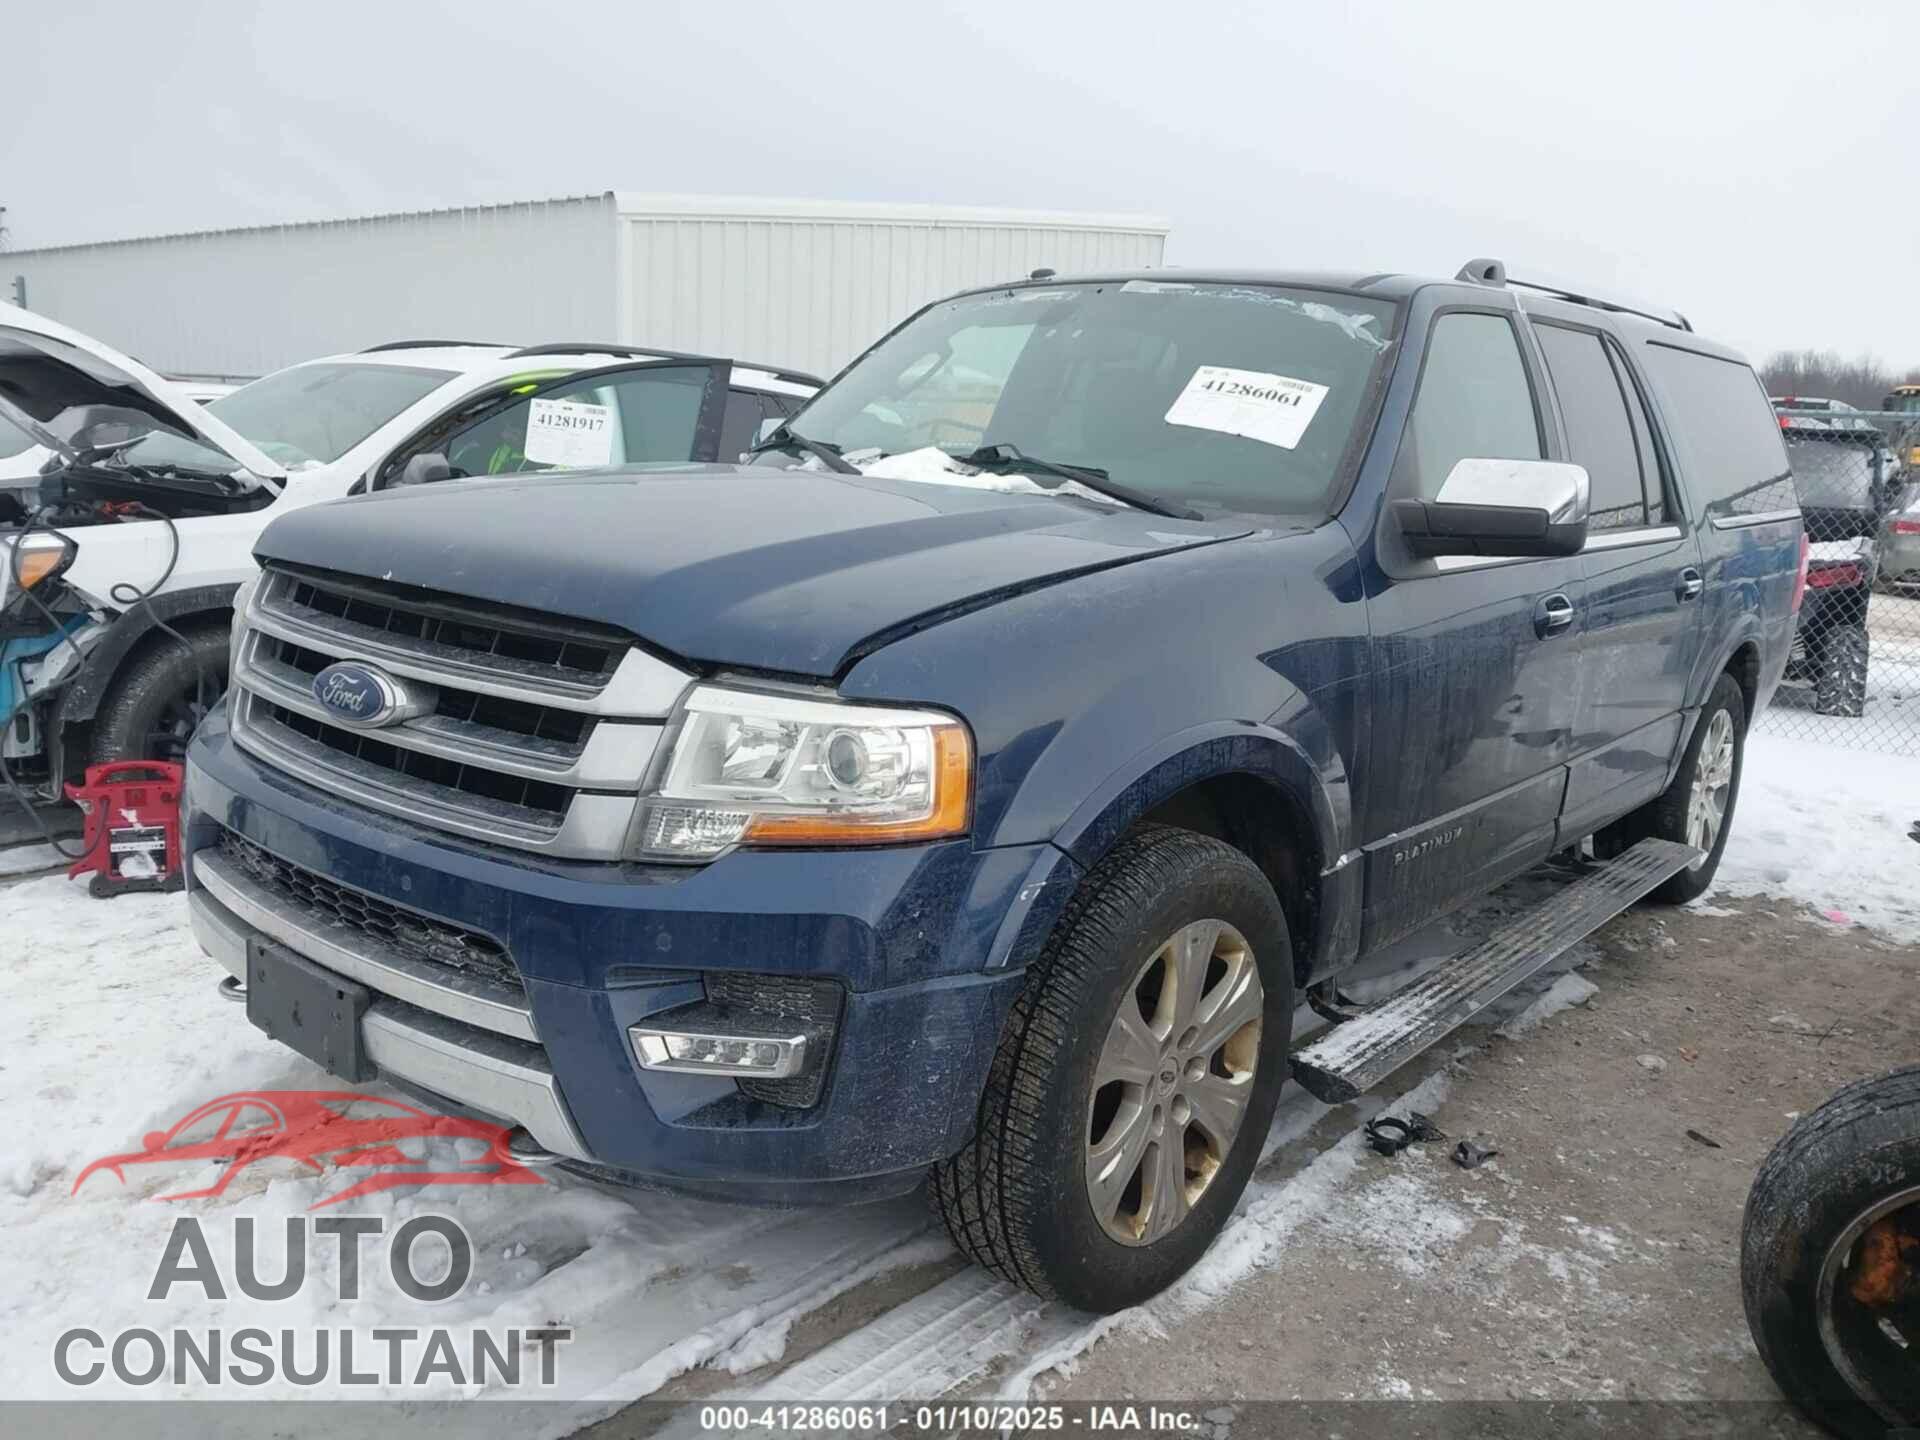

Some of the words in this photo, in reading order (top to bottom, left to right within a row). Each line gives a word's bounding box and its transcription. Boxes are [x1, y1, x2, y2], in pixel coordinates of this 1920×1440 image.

[1202, 379, 1303, 407] 41286061
[538, 413, 604, 431] 41281917
[322, 672, 368, 712] Ford
[1394, 827, 1462, 866] PLATINUM
